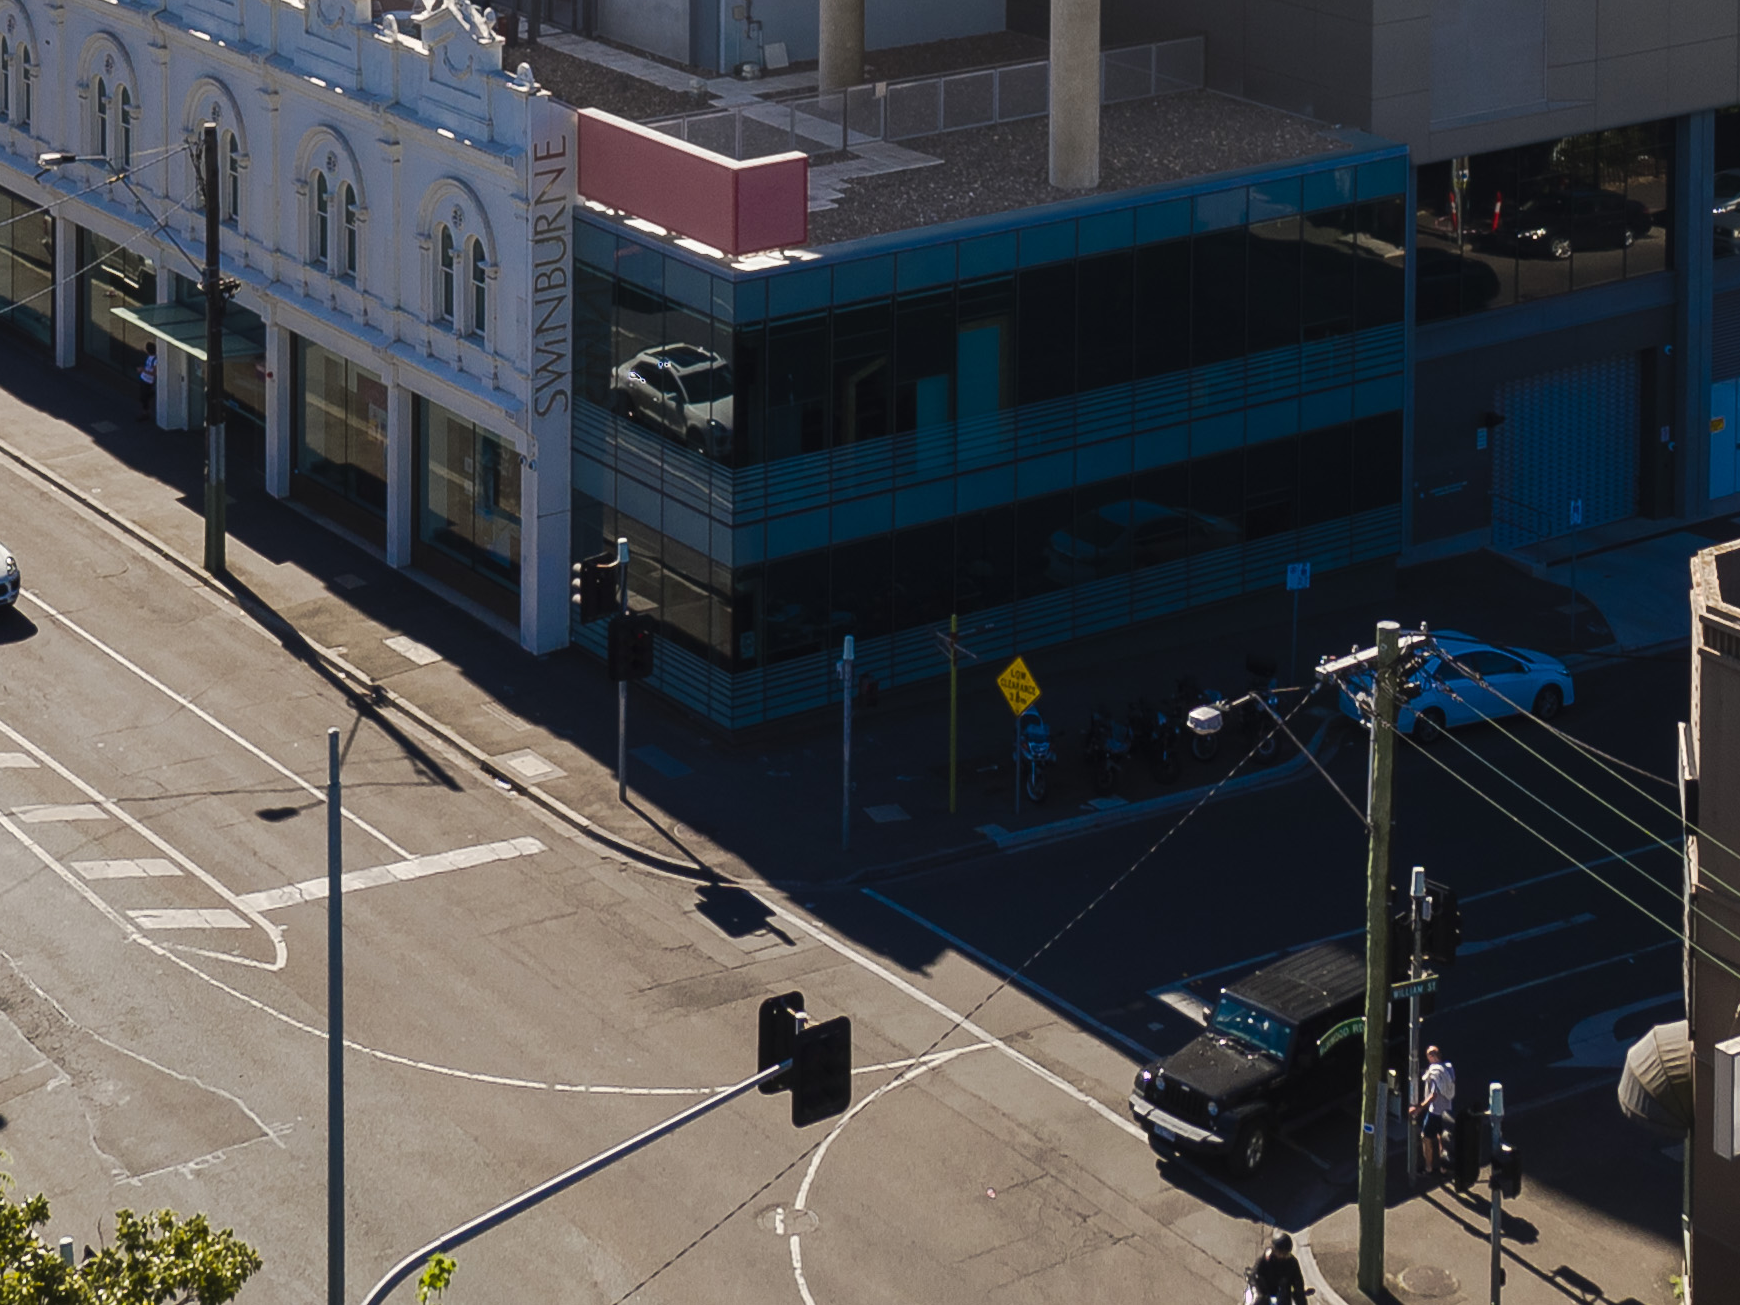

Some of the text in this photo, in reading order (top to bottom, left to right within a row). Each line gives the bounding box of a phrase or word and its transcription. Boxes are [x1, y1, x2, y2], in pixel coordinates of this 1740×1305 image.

[533, 133, 569, 418] SWINBURNE
[1010, 669, 1026, 680] LOW
[1393, 981, 1436, 999] WILLIAM ST
